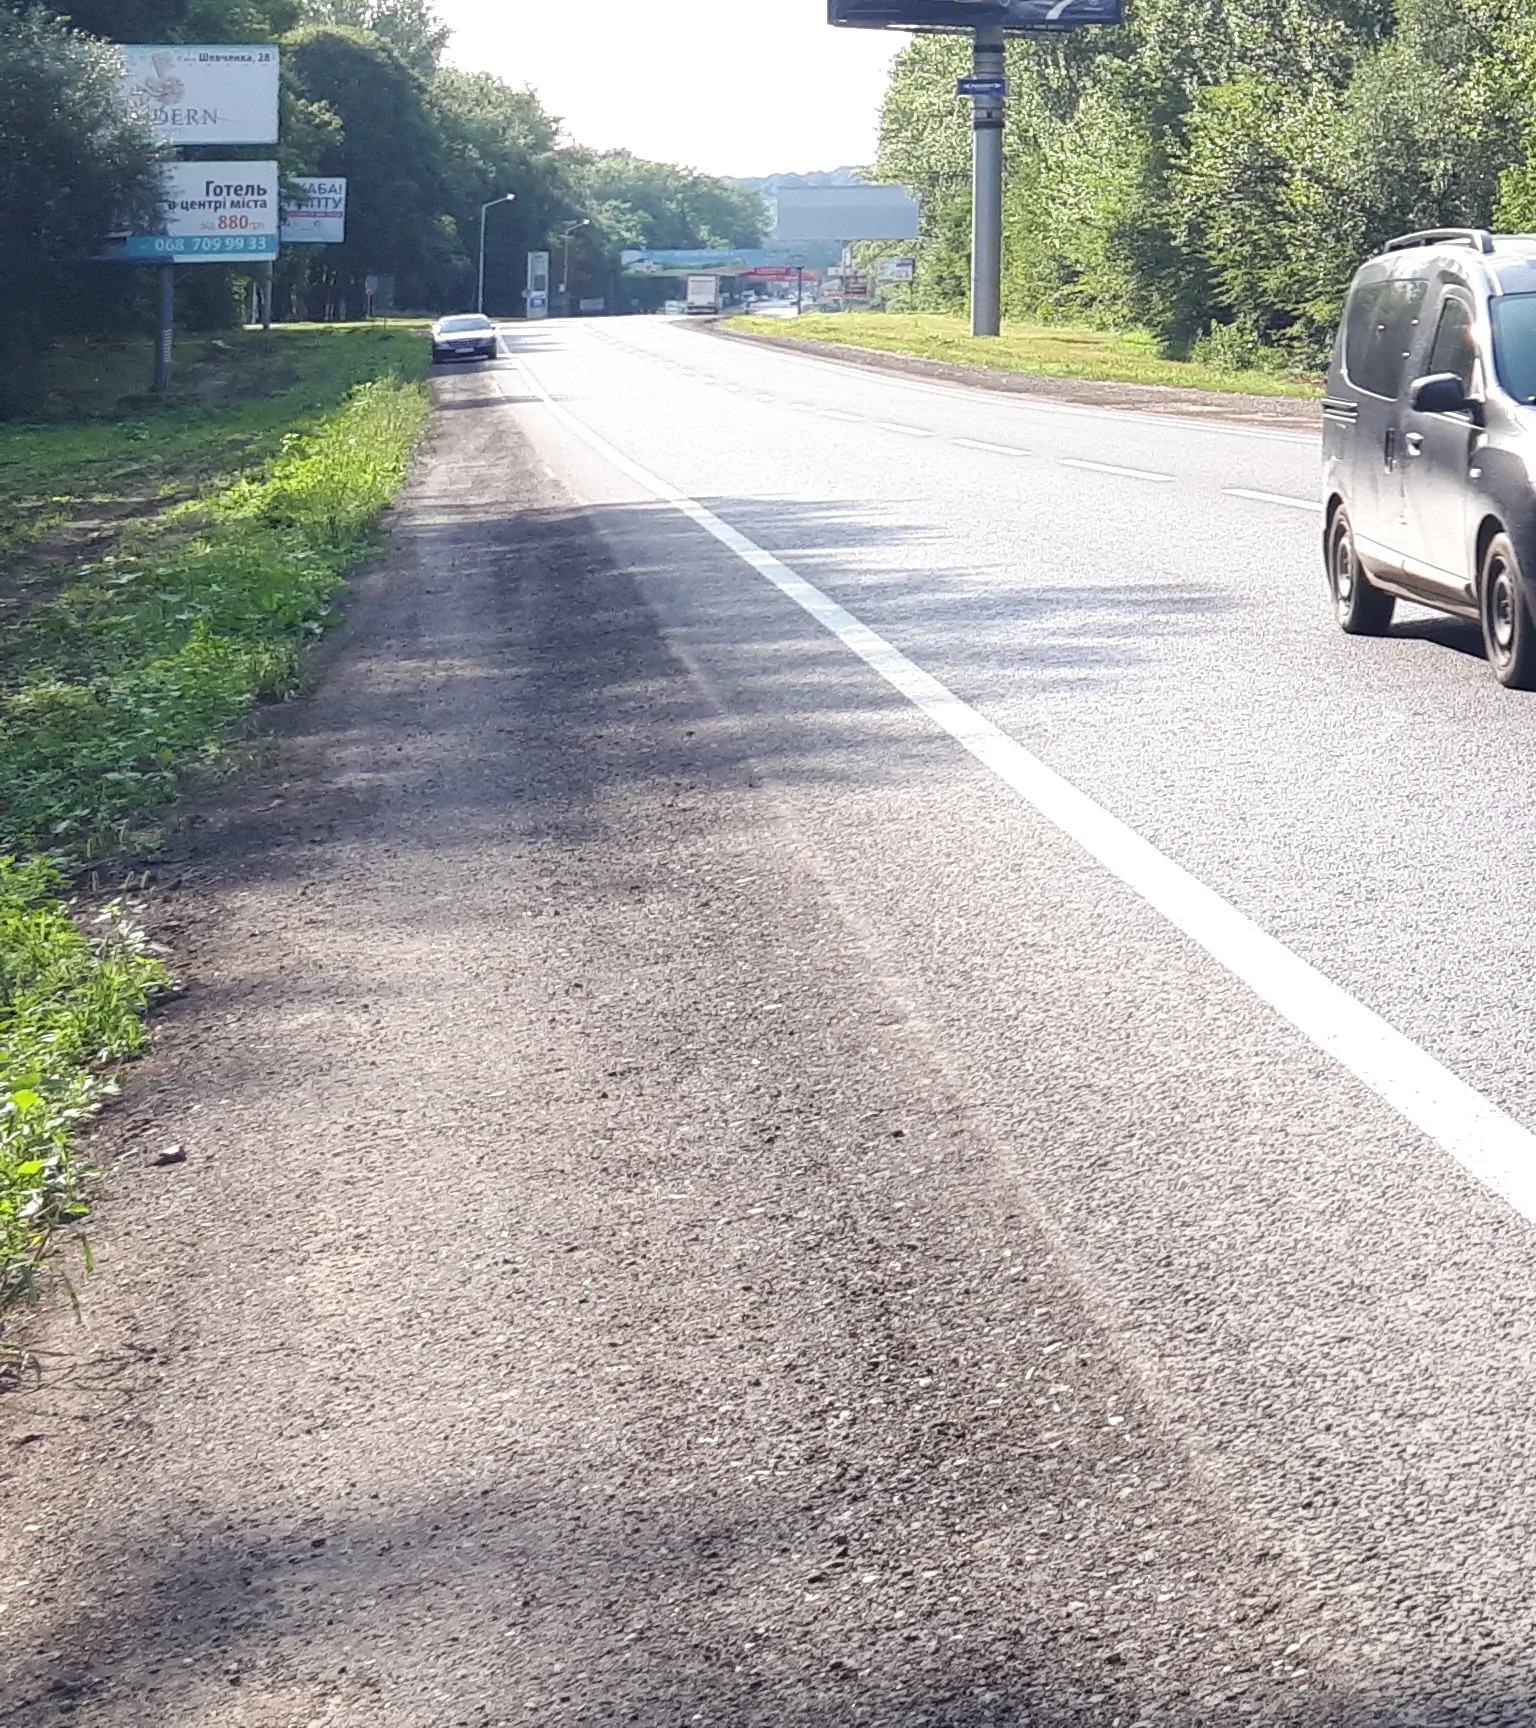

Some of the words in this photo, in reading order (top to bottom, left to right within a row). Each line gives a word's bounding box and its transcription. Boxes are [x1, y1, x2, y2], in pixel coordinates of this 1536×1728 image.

[258, 53, 270, 62] 28
[153, 108, 218, 126] DERN
[205, 181, 268, 197] Готель
[180, 197, 227, 212] центрі
[230, 197, 268, 209] міста
[217, 215, 249, 230] 880
[154, 238, 185, 251] 068
[192, 238, 222, 251] 709
[224, 237, 245, 250] 99
[247, 236, 267, 250] 33
